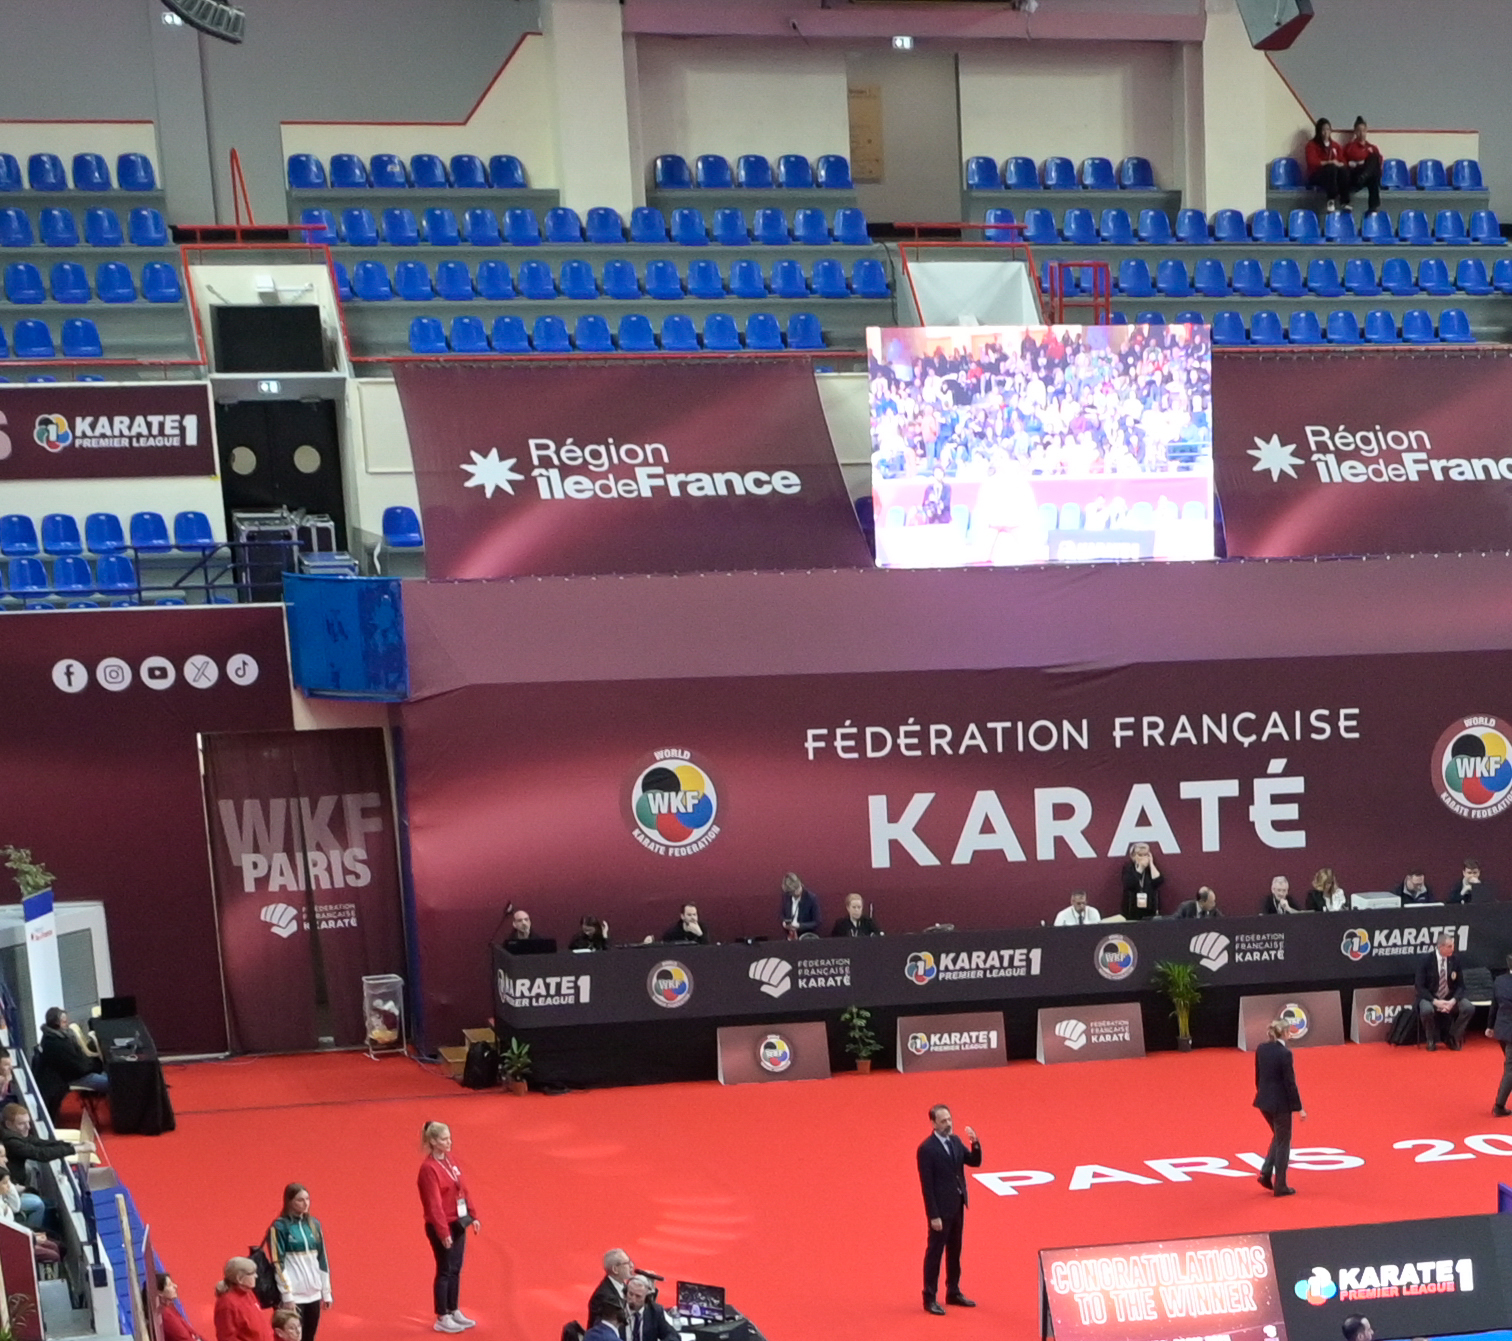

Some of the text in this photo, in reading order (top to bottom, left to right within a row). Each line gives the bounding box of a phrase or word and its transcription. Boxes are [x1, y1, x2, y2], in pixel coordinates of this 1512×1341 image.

[74, 436, 180, 448] PREMIER LEAGUE
[1304, 425, 1431, 459] Région
[528, 438, 669, 472] Région
[804, 707, 1362, 761] FÉDÉRATION FRANÇAISE
[1463, 717, 1496, 728] WORLD
[653, 749, 691, 761] WORLD
[1455, 756, 1502, 779] WKF
[647, 791, 700, 815] WKF
[868, 758, 1306, 868] KARATÉ
[1440, 792, 1469, 817] KARATE
[218, 792, 384, 867] WKF
[631, 824, 721, 857] KARATE FEDERATION
[241, 848, 371, 893] PARIS
[1235, 949, 1285, 963] KARATÉ
[1372, 945, 1415, 956] PREMIER
[798, 974, 851, 989] KARATÉ
[939, 967, 1027, 981] PREMIER LEAGUE
[532, 995, 575, 1006] LEAGUE
[1091, 1032, 1131, 1044] KARATÉ
[974, 1147, 1364, 1197] PARIS
[1050, 1245, 1270, 1295] CONGRATULATIONS
[1074, 1280, 1258, 1326] TO THE WINNER
[1339, 1281, 1456, 1302] PREMIER LEAGUE
